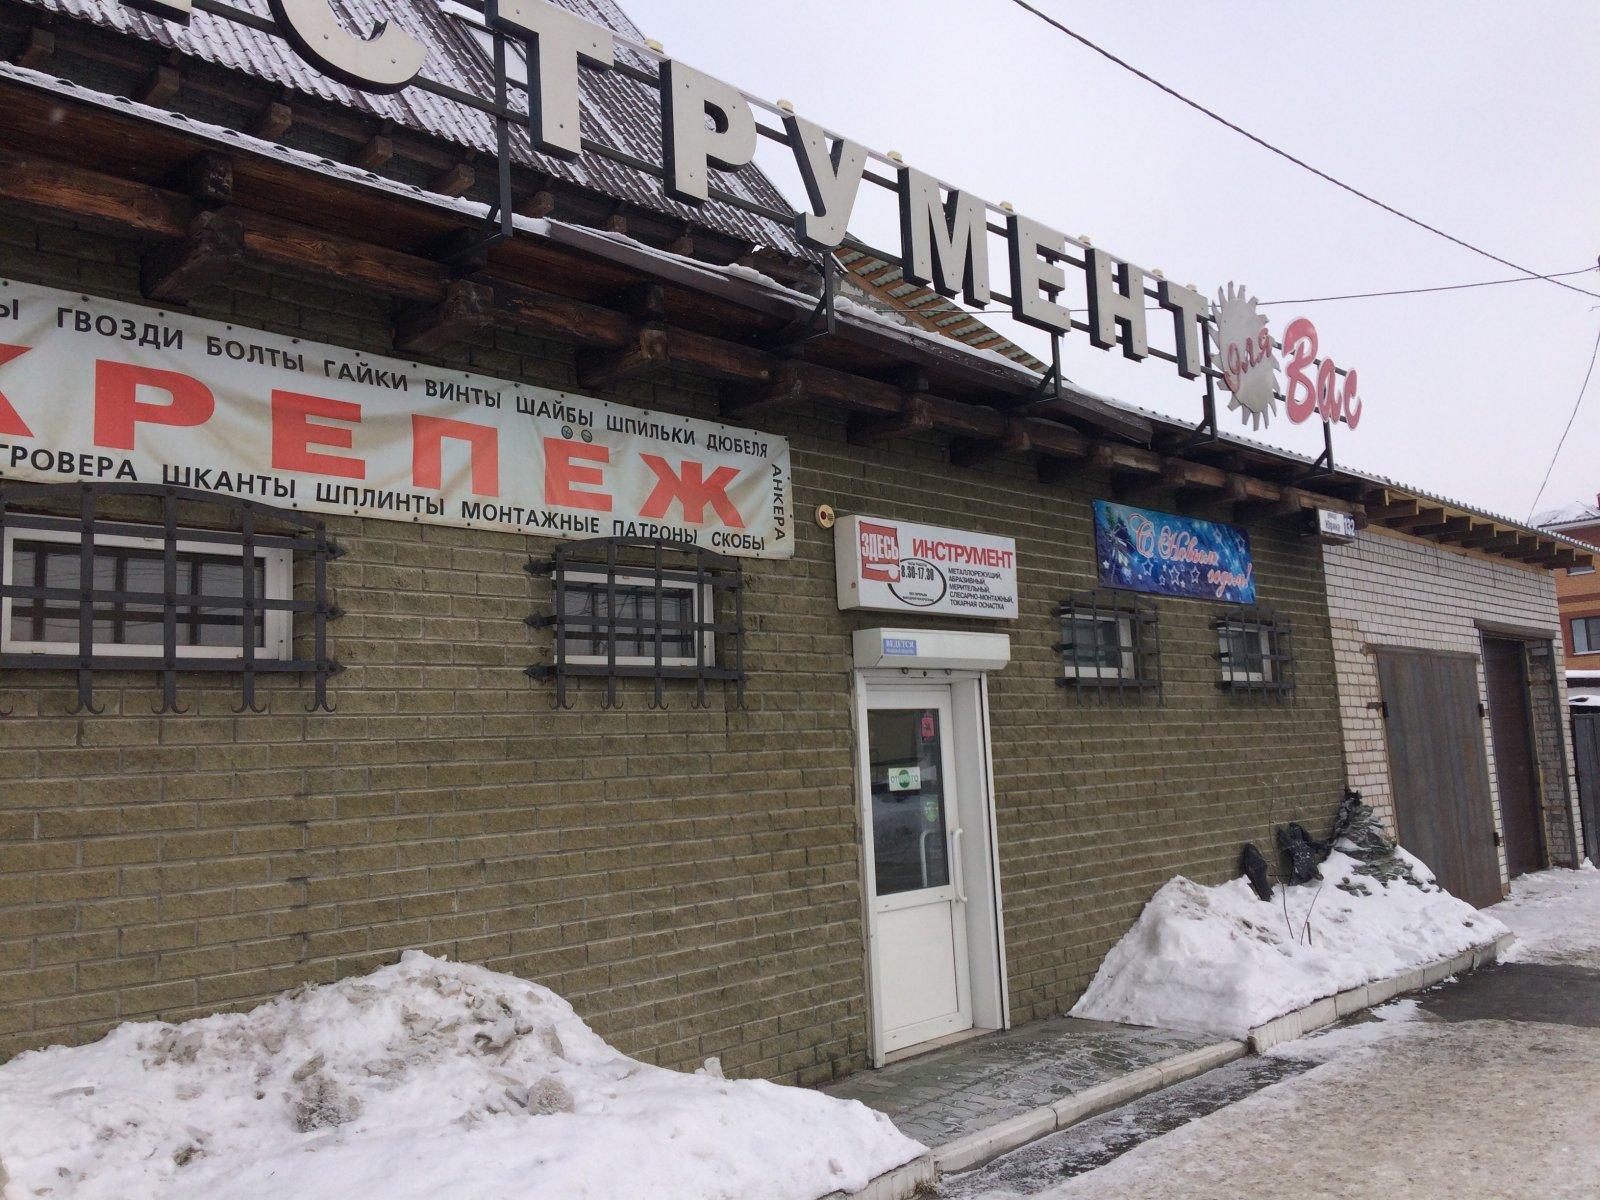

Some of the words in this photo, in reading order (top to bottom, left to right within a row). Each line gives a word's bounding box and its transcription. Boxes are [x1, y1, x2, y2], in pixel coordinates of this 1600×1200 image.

[118, 0, 1209, 380] СТРУМЕНТ
[1282, 316, 1362, 430] Вас
[57, 307, 183, 350] ГВОЗДИ
[206, 335, 304, 373] БОЛТЫ
[323, 359, 408, 392] ГАЙКИ
[425, 378, 501, 410] ВИНТЫ
[516, 396, 594, 428] ШАЙБЫ
[606, 414, 696, 446] ШПИЛЬКИ
[706, 433, 769, 459] ДЮБЕЛЯ
[162, 463, 296, 499] ШКАНТЫ
[315, 482, 444, 516] ШПЛИНТЫ
[461, 500, 600, 534] МОНТАЖНЫЕ
[612, 519, 698, 545] ПАТРОНЫ
[711, 531, 765, 551] СКОБЫ
[771, 463, 786, 541] АНКЕРА
[861, 532, 899, 561] ЗДЕСЬ
[912, 538, 1013, 569] ИНСТРУМЕНТ
[1127, 512, 1155, 559] С
[1158, 525, 1219, 566] Новым
[951, 599, 977, 608] ТОКАРНАЯ
